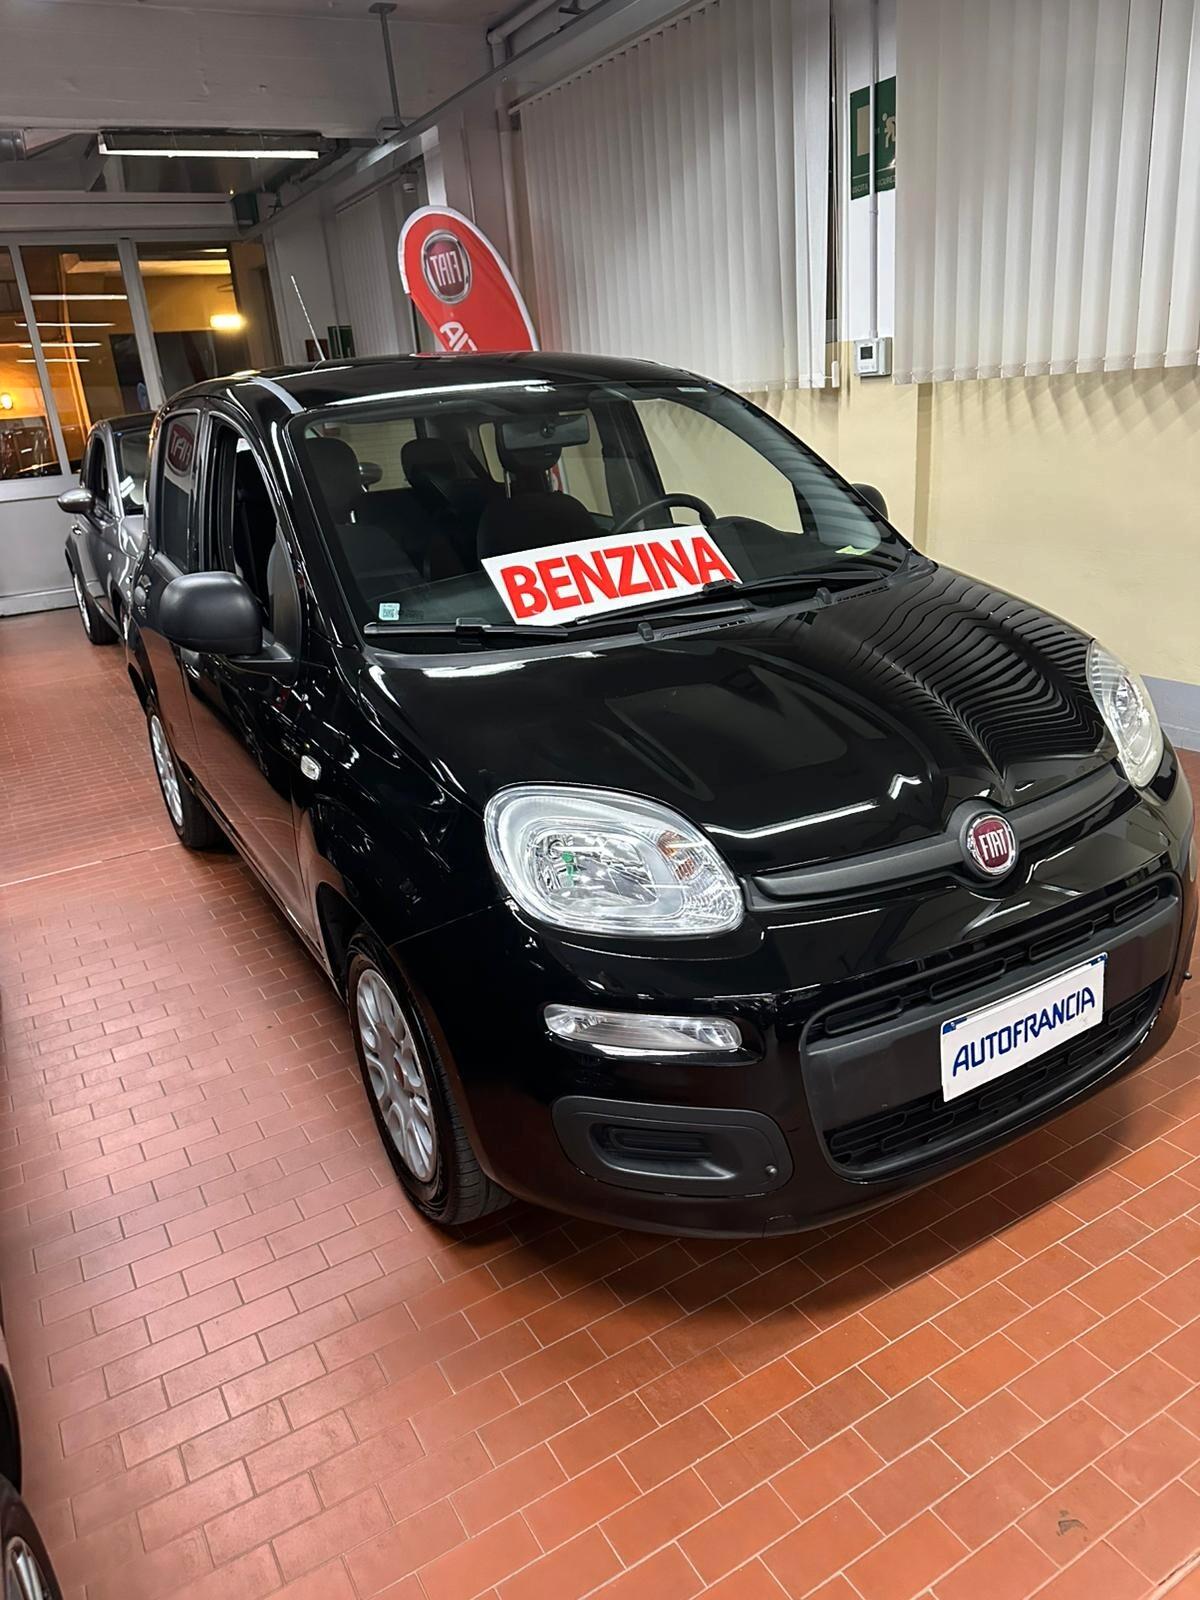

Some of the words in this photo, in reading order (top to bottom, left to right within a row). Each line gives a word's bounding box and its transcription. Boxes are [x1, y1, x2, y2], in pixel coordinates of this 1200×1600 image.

[500, 536, 736, 619] BENZINA
[978, 828, 1007, 861] FIAT
[952, 986, 1095, 1077] AUTOFRANCIA
